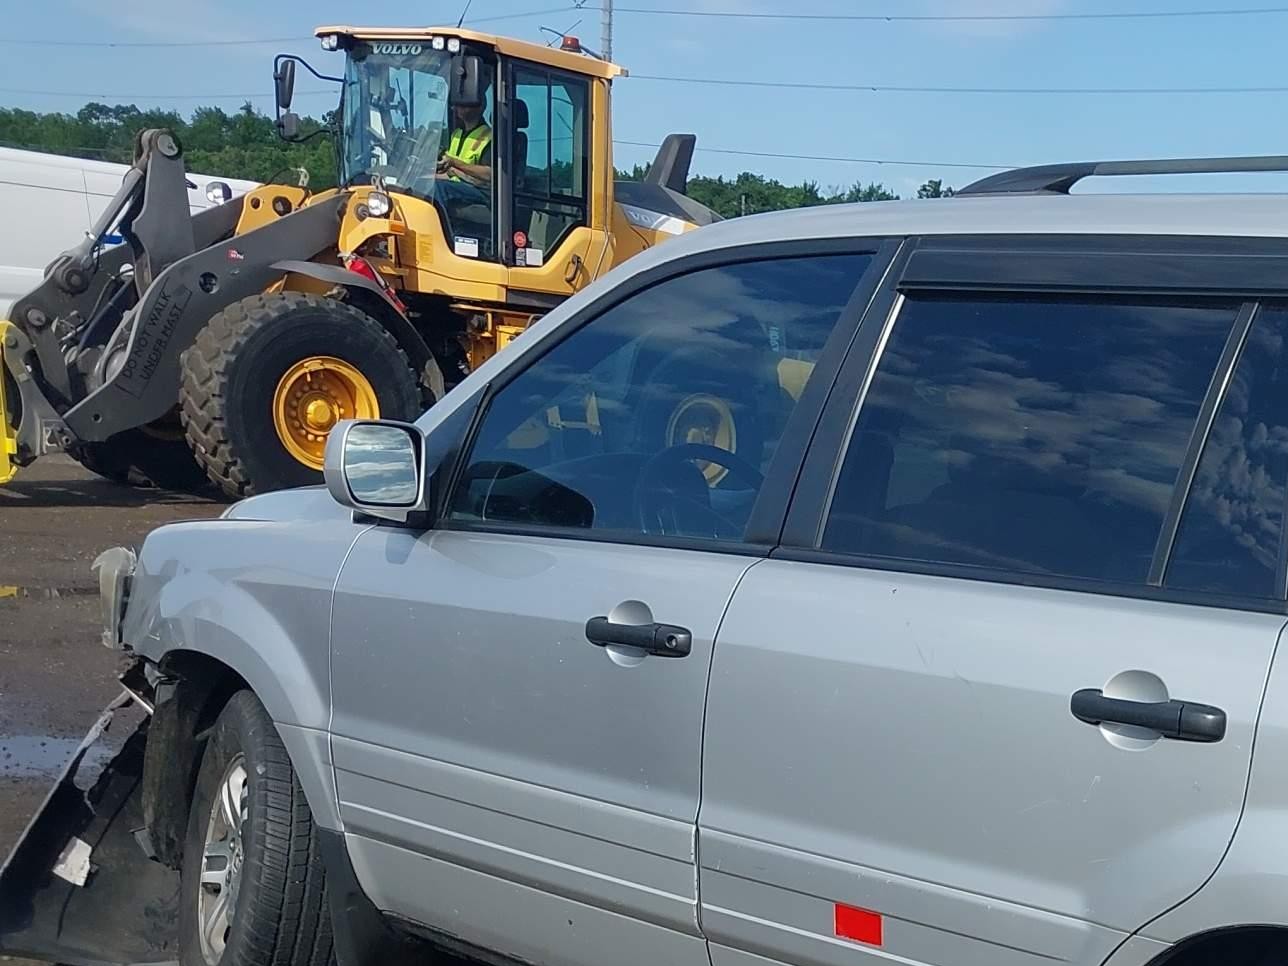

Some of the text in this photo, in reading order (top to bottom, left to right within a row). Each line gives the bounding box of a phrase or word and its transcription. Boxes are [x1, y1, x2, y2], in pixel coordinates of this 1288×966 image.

[373, 43, 422, 55] VOLVO
[122, 290, 171, 378] DO NOT WALK
[140, 303, 182, 380] UNDER MAST
